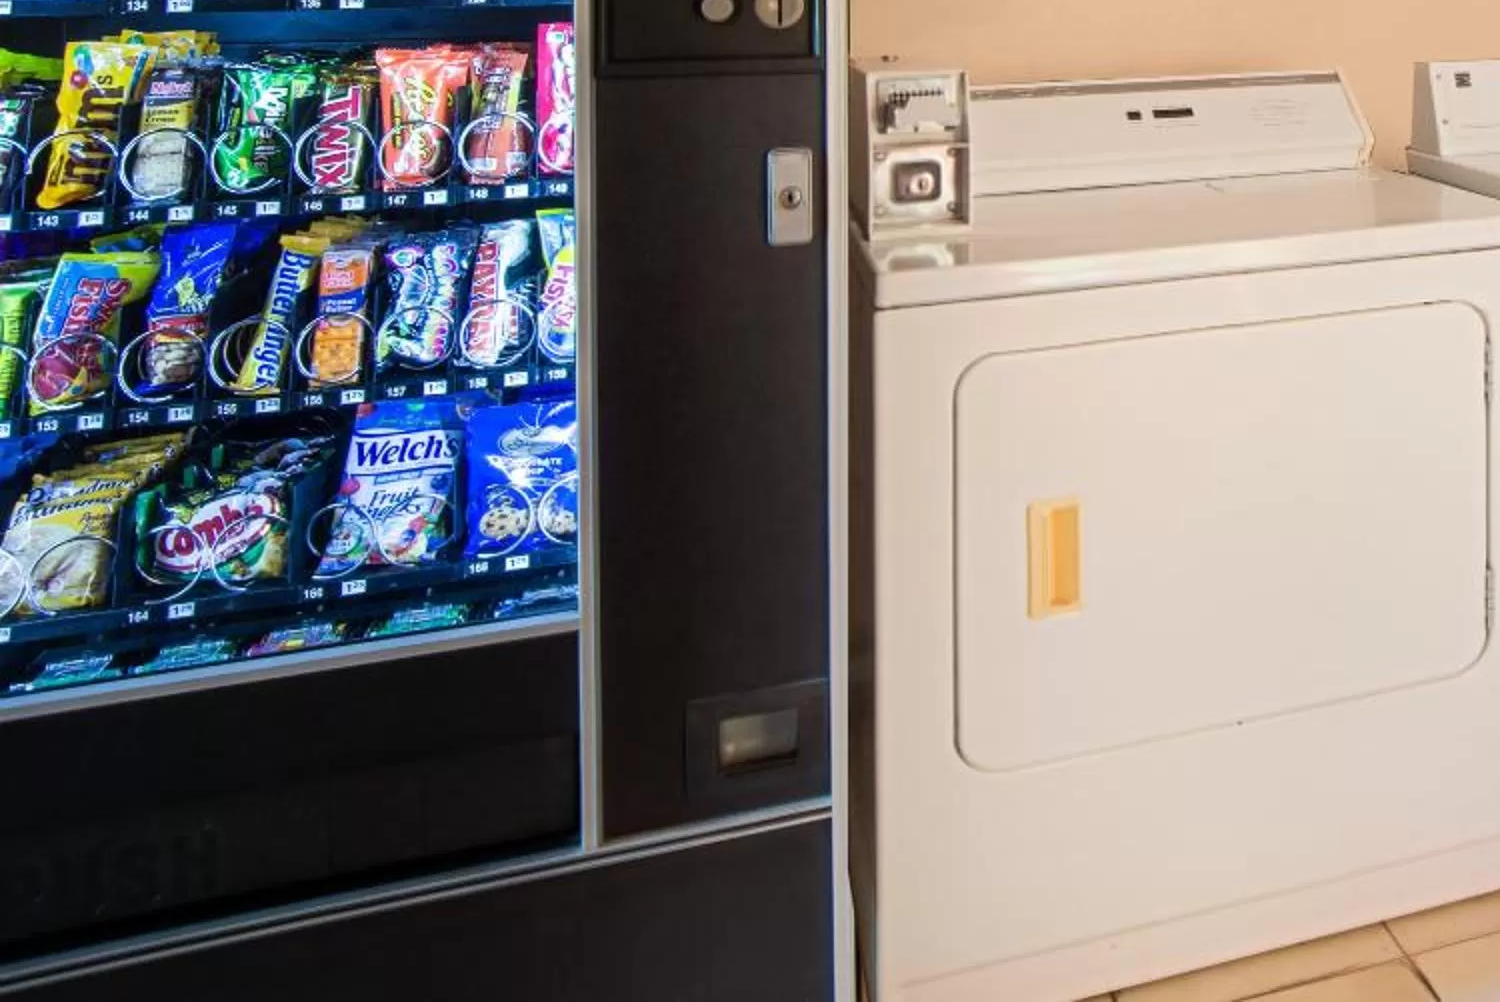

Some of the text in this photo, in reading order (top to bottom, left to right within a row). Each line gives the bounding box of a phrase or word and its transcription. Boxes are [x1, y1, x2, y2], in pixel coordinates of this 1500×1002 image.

[126, 0, 149, 12] 134
[315, 85, 362, 189] TWIX
[388, 195, 408, 206] 147
[37, 215, 60, 227] 143
[128, 209, 150, 221] 144
[128, 411, 150, 424] 154
[36, 418, 59, 431] 153
[355, 433, 460, 468] Welch's
